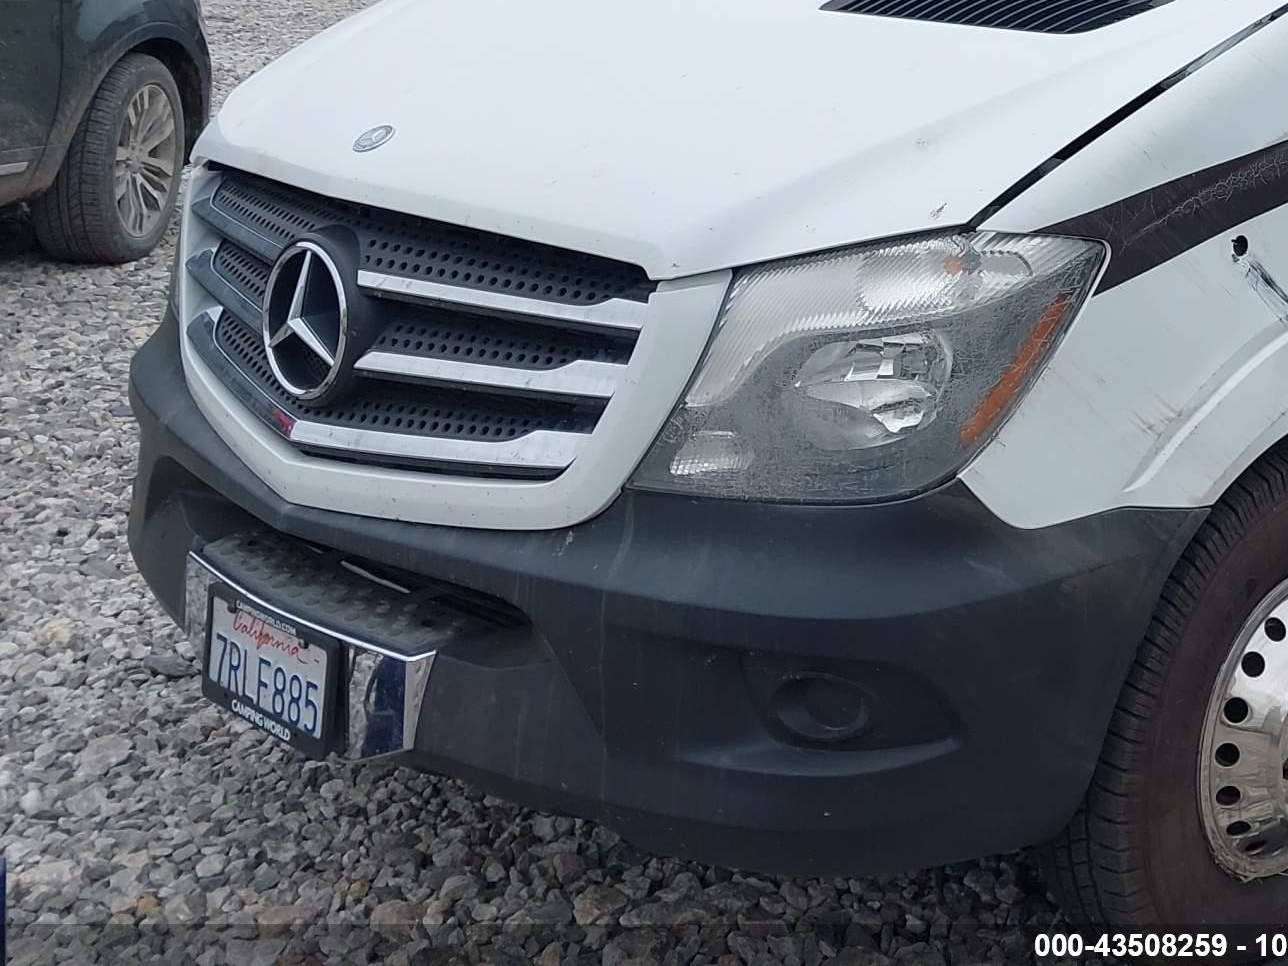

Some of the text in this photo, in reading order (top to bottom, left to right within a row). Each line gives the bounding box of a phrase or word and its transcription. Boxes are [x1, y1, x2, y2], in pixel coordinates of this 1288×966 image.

[215, 632, 319, 735] 7RLF885
[231, 699, 291, 741] CAMPING WORLD
